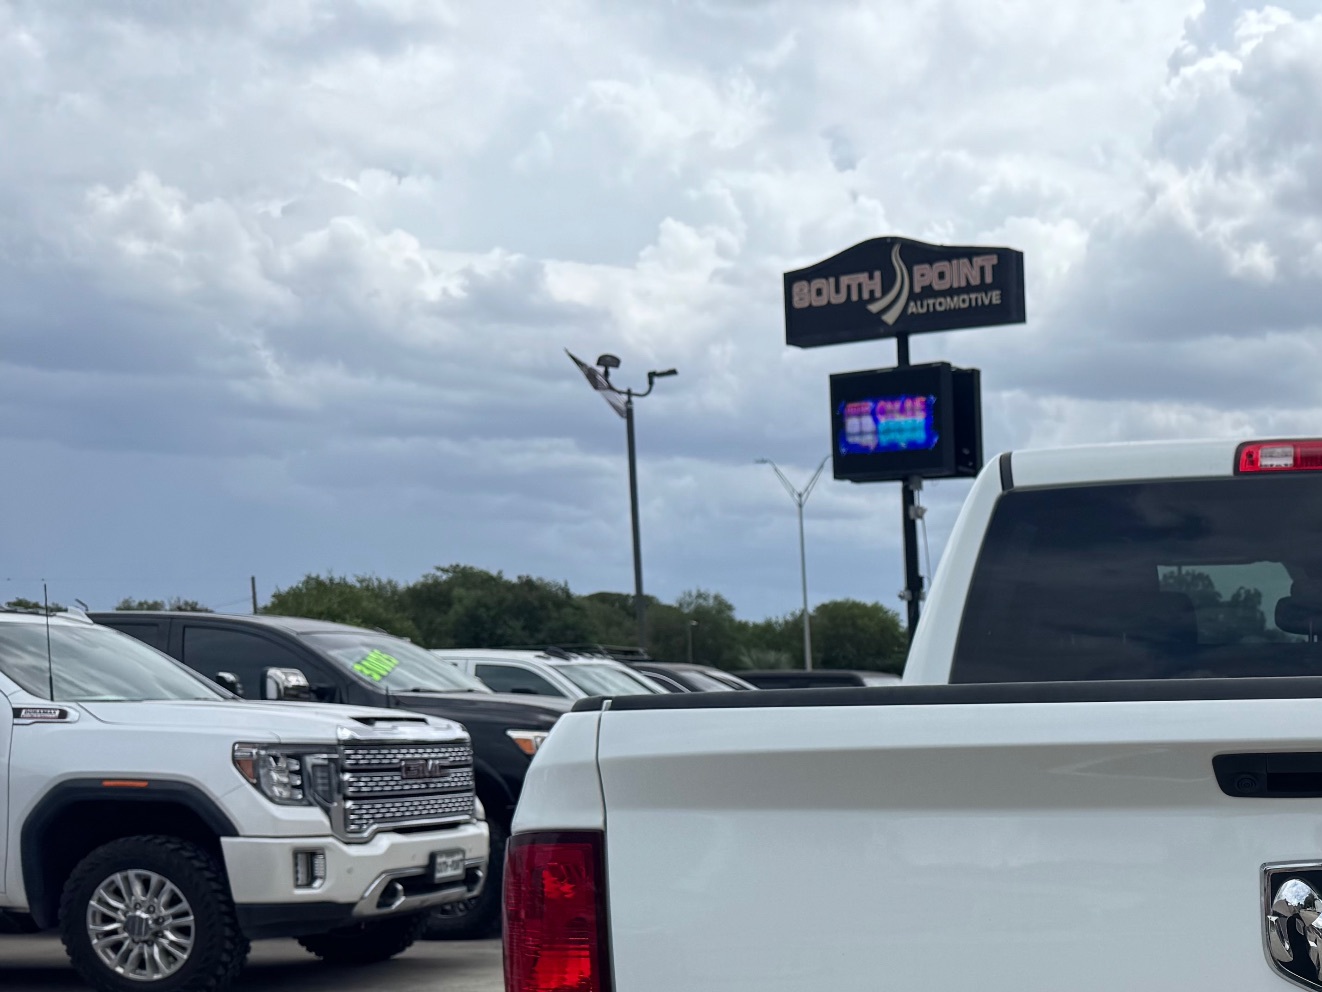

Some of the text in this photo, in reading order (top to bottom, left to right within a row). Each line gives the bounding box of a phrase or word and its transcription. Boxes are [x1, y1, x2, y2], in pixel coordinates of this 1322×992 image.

[792, 254, 998, 309] SOUTH POINT
[907, 290, 1002, 316] AUTOMOTIVE
